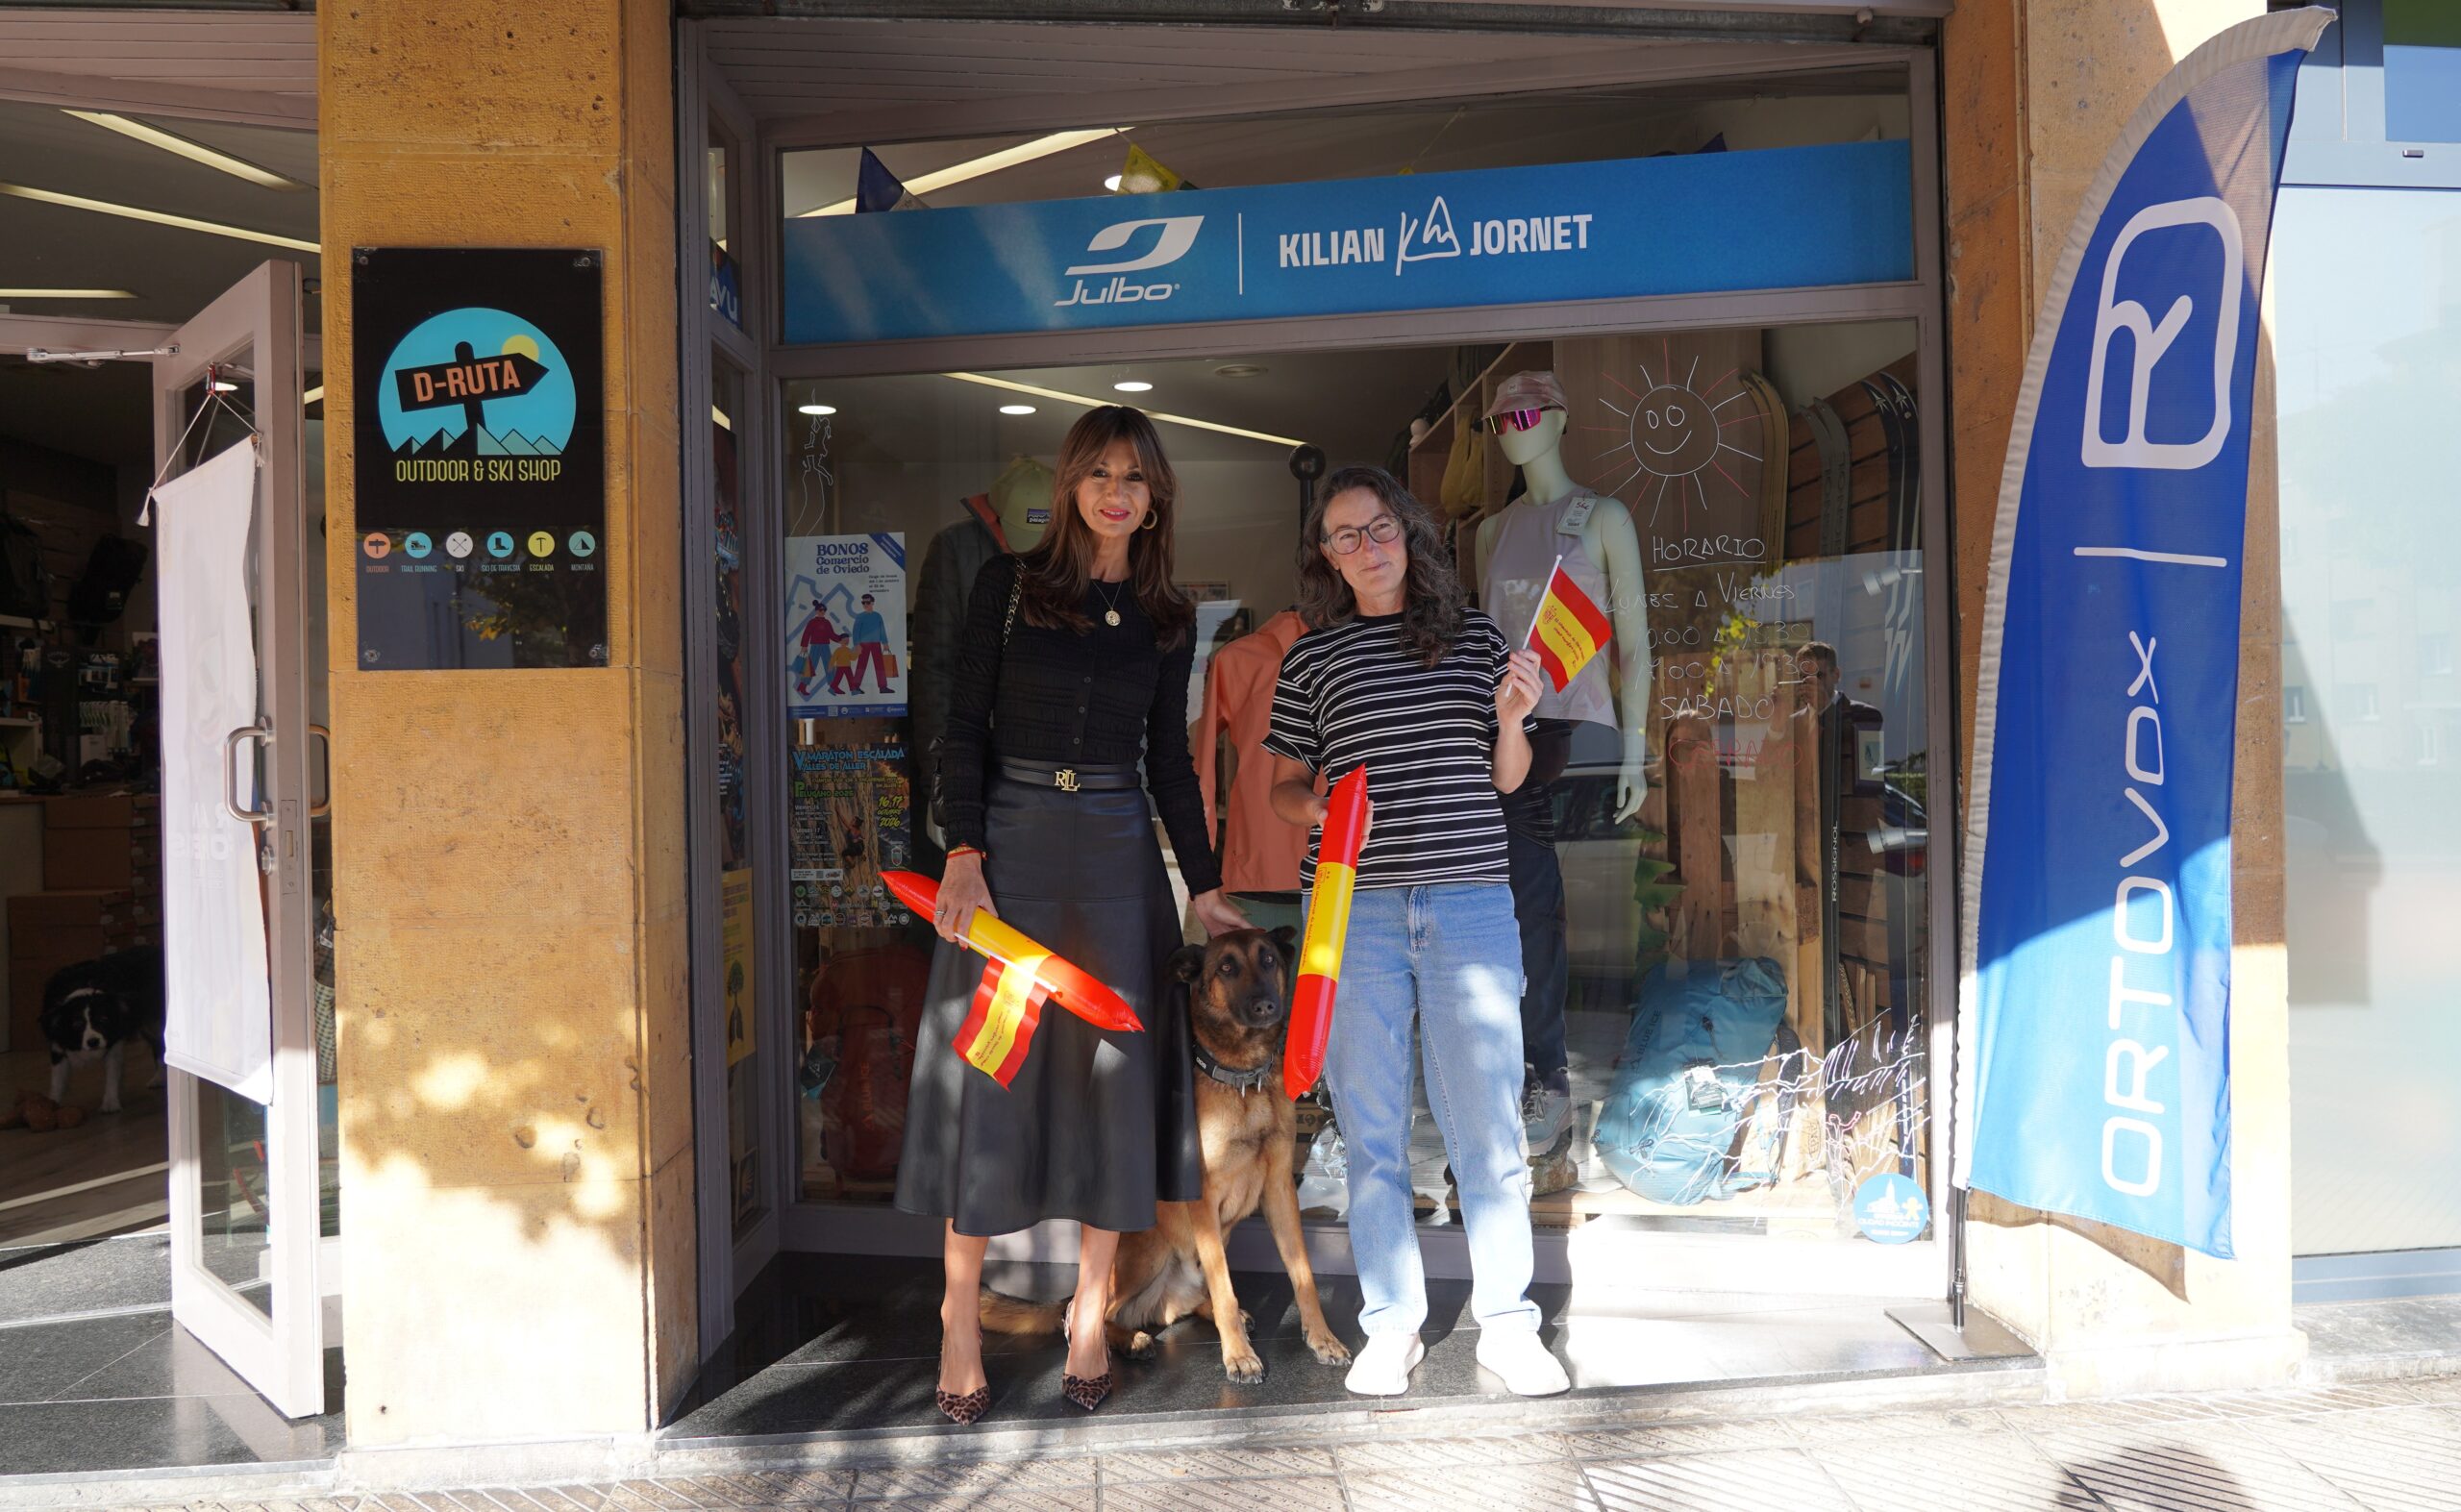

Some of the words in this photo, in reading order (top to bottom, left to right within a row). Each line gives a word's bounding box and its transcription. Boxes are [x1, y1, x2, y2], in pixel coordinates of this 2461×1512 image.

[1280, 228, 1384, 268] KILIAN
[1470, 213, 1593, 257] JORNET
[413, 359, 521, 403] D-RUTA
[395, 459, 469, 483] OUTDOOR
[473, 460, 485, 482] &
[488, 460, 514, 482] SKI
[517, 459, 561, 482] SHOP
[816, 543, 869, 557] BONOS
[816, 555, 869, 566] Comercio
[1653, 534, 1766, 564] HORARIO
[529, 563, 555, 573] ESCALADA
[816, 566, 830, 575] de
[833, 564, 870, 575] Oviedo
[2101, 631, 2175, 1199] ORTOVOX
